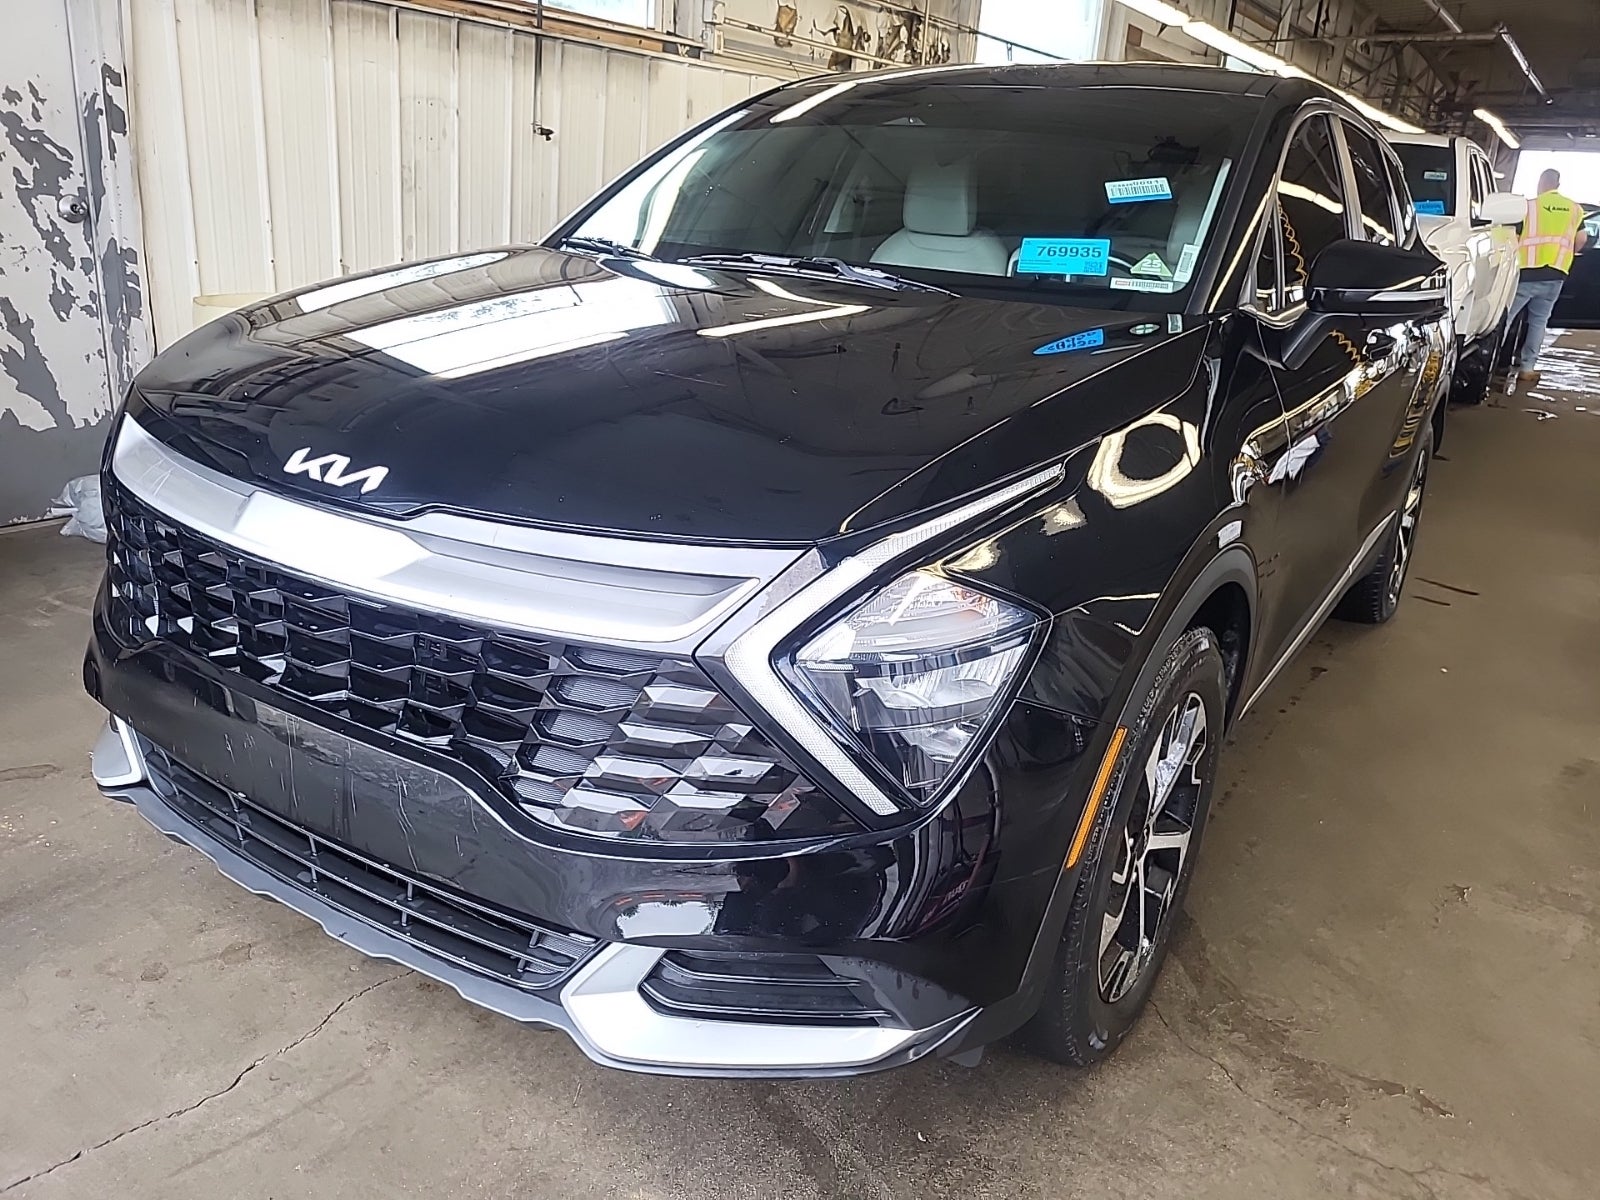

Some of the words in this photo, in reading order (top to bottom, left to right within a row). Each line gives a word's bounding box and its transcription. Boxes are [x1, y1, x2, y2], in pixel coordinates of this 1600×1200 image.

[1036, 245, 1102, 258] 769935
[1141, 259, 1161, 268] 25
[283, 447, 390, 495] KIA
